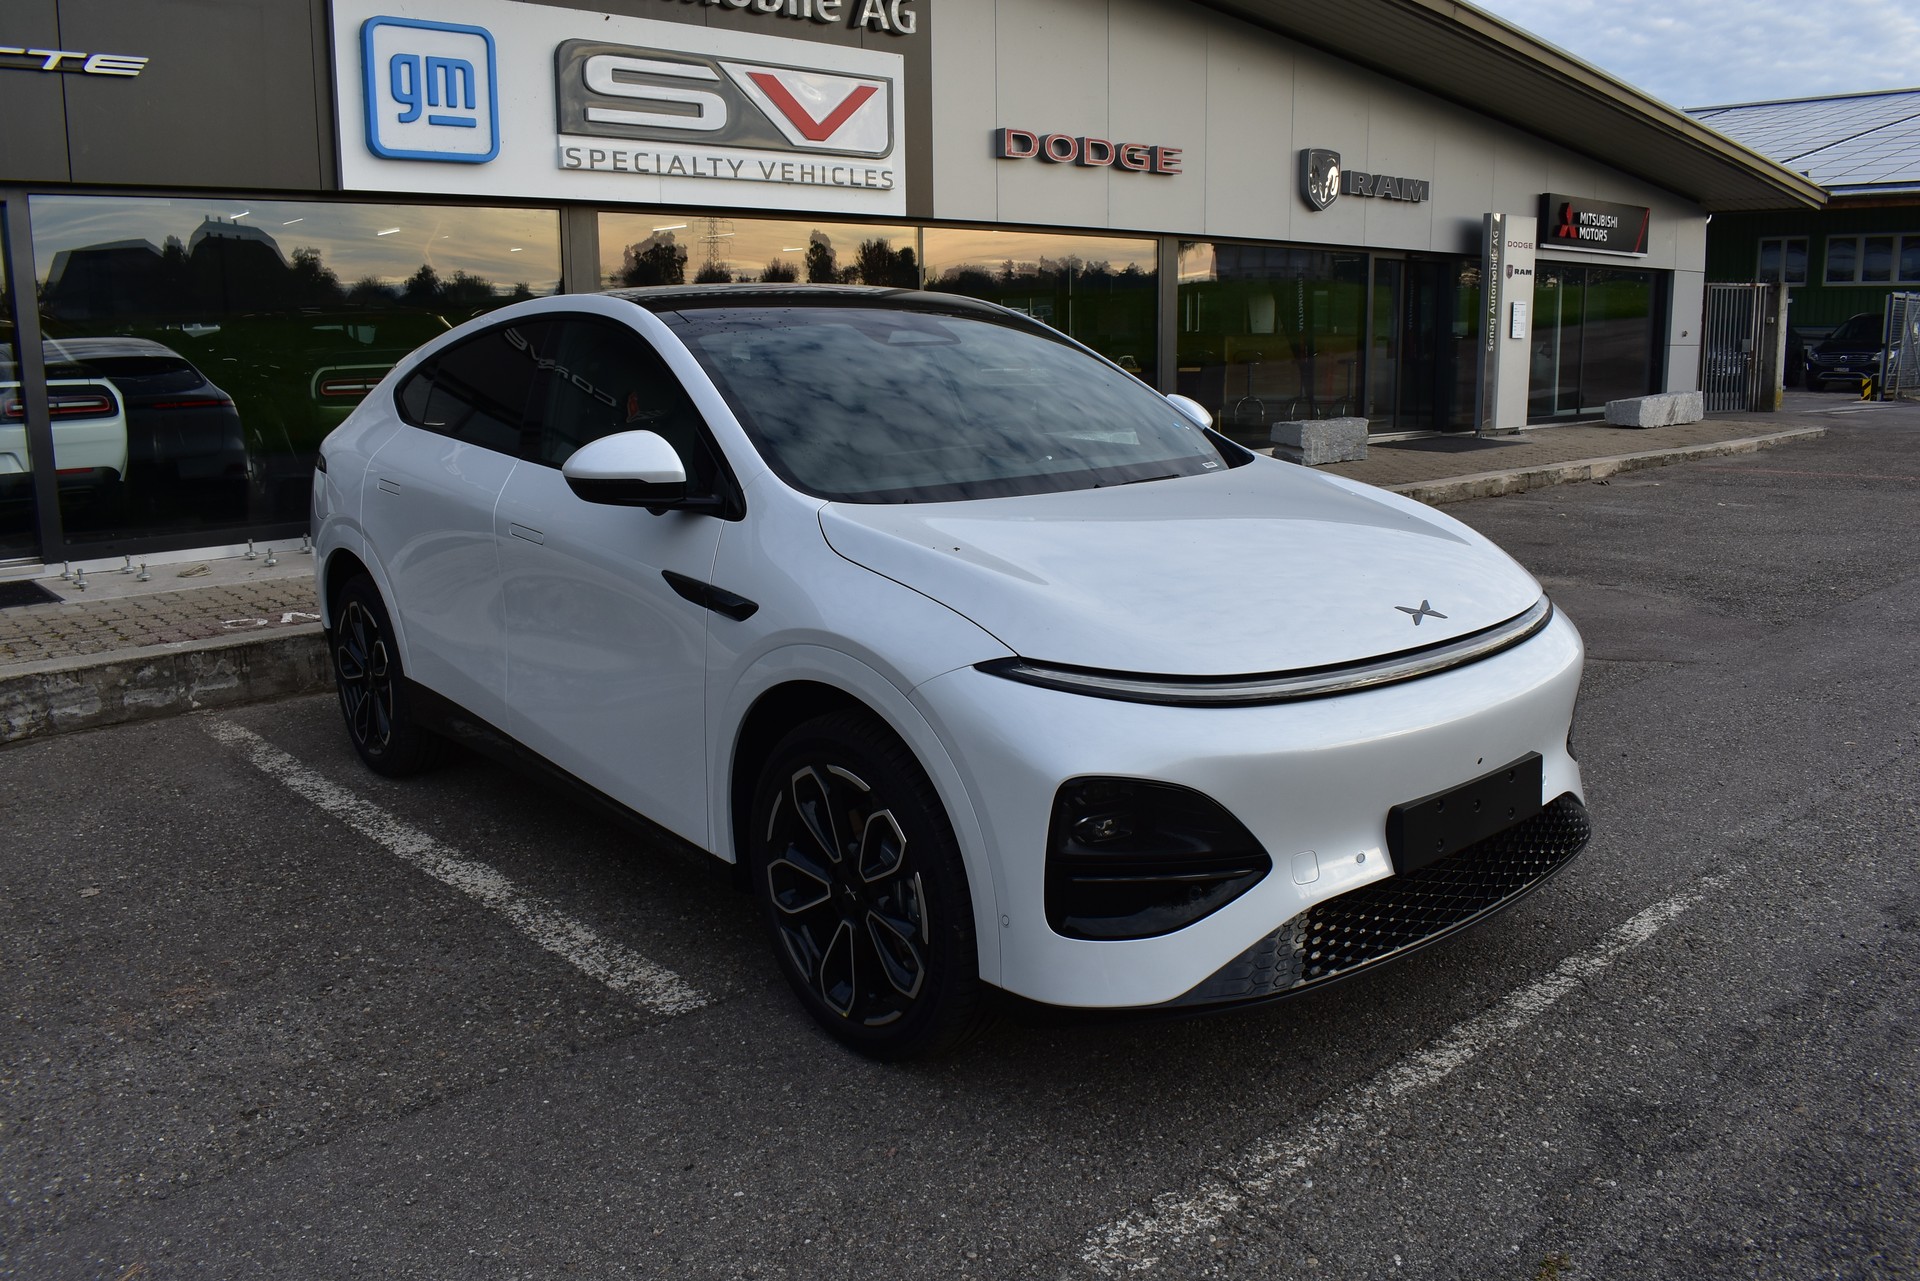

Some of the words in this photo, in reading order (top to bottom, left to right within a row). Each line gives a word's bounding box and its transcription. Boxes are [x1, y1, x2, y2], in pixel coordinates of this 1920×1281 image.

[860, 0, 917, 33] AG
[389, 53, 477, 128] gm
[583, 54, 884, 142] SV
[1000, 127, 1183, 174] DODGE
[565, 147, 744, 178] SPECIALTY
[758, 160, 894, 189] VEHICLES
[1346, 170, 1430, 202] RAM
[1579, 227, 1608, 241] MOTORS
[1580, 212, 1618, 228] MITSUBISHI
[1507, 240, 1534, 249] DODGE
[1514, 268, 1533, 276] RAM
[1487, 317, 1497, 352] Senag
[1492, 230, 1499, 246] AG
